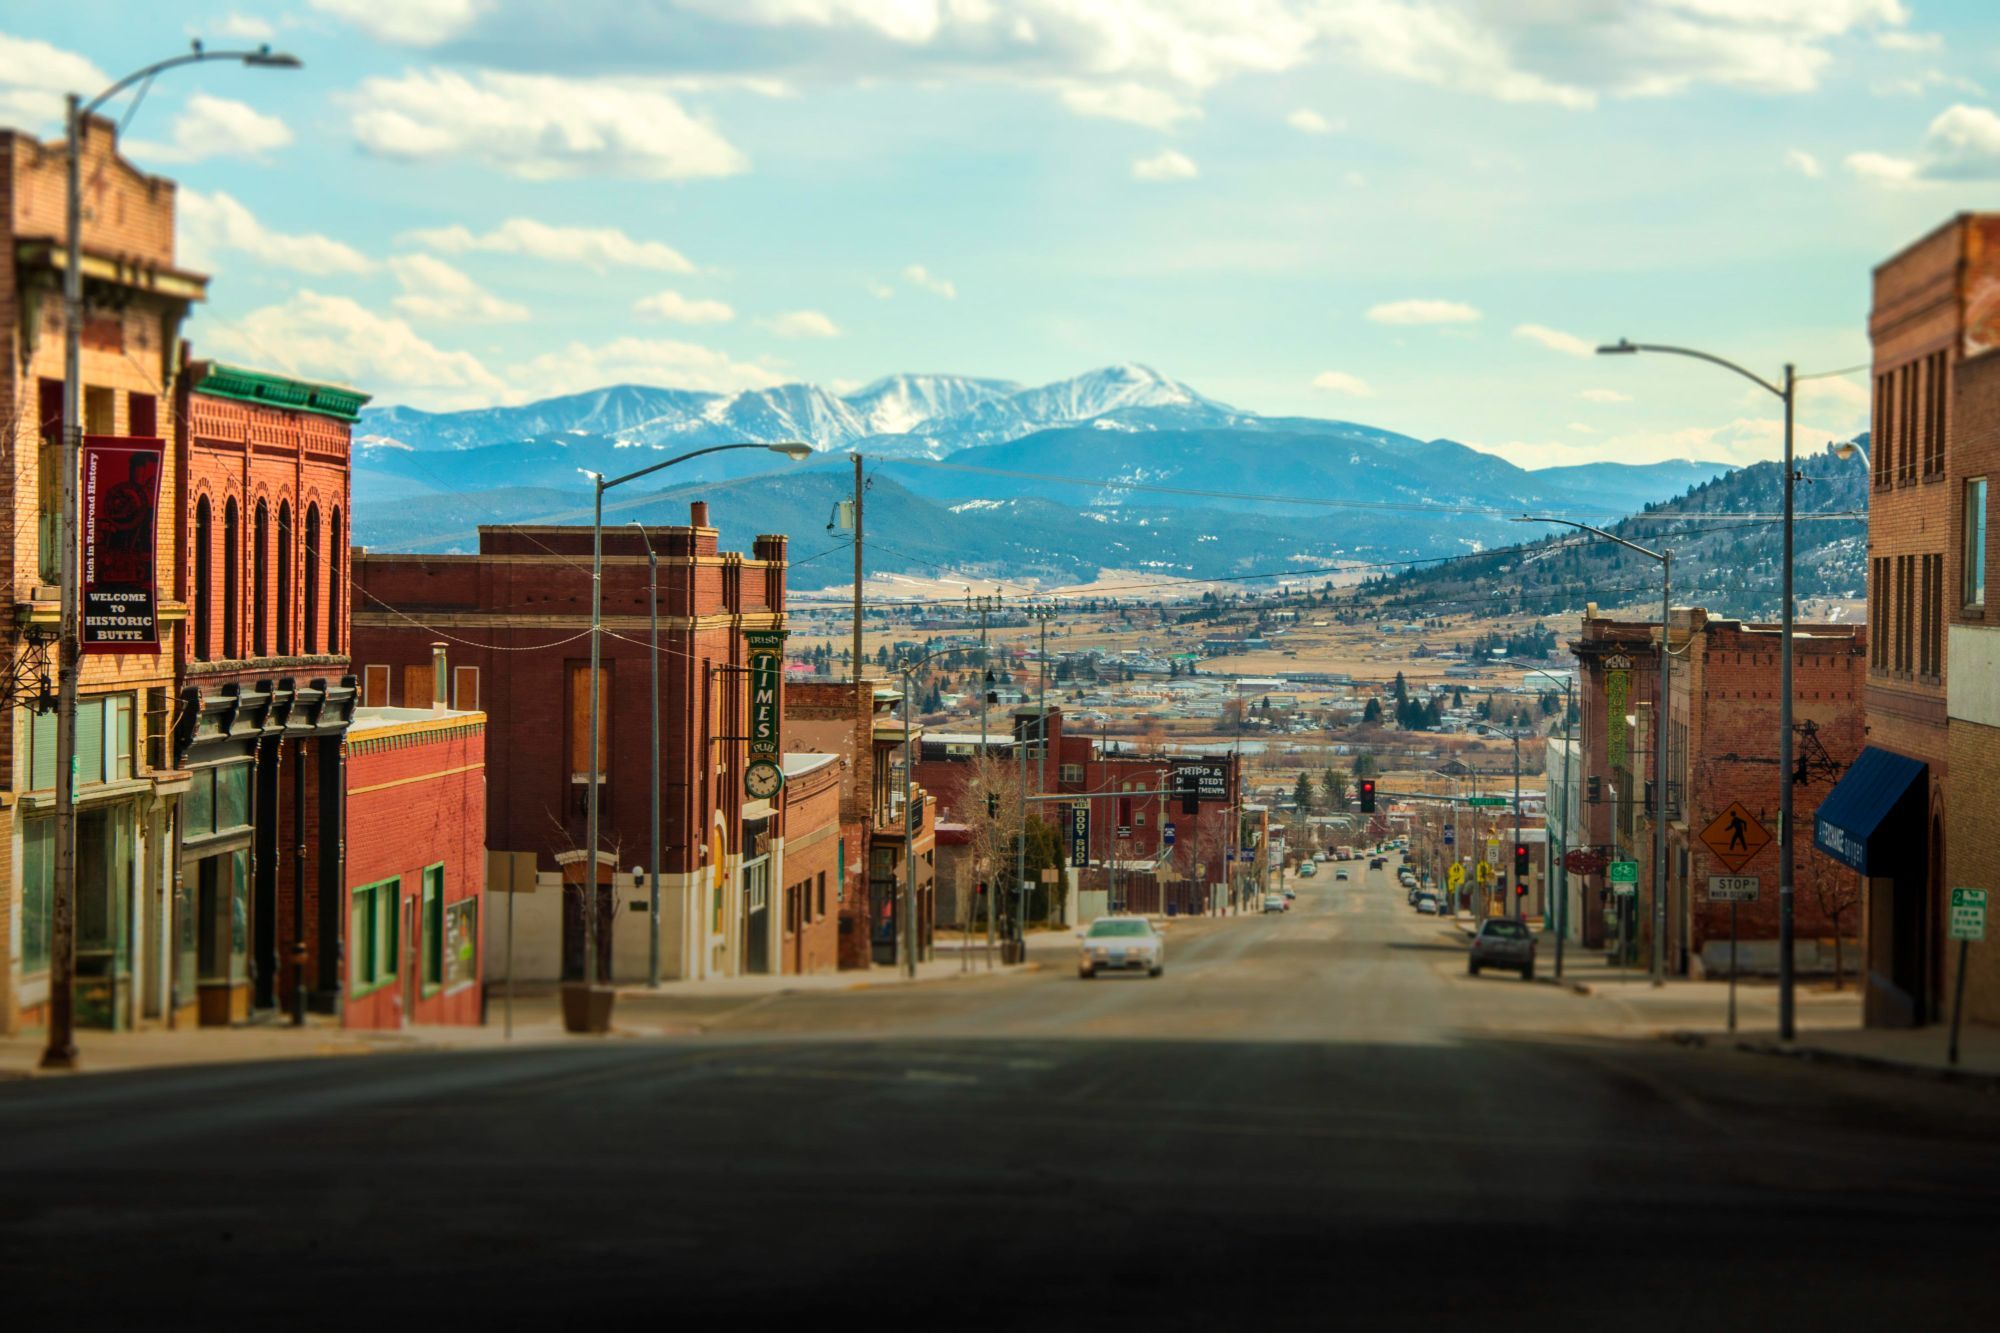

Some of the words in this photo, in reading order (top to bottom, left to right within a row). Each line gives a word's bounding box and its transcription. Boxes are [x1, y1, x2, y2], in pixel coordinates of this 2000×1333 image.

[87, 453, 99, 495] History
[86, 495, 96, 544] Railroad
[86, 545, 95, 556] in
[86, 557, 95, 583] Rich
[90, 593, 147, 602] WELCOME
[110, 605, 126, 613] TO
[86, 616, 153, 626] HISTORIC
[97, 630, 143, 640] BUTTE
[755, 655, 773, 738] TIMES
[753, 743, 774, 753] PUB
[1177, 767, 1211, 776] TRIPP
[1213, 768, 1223, 777] &
[1176, 777, 1225, 786] DSTEDT
[1076, 810, 1086, 836] BODY
[1075, 839, 1086, 865] SHOP
[1719, 879, 1750, 889] STOP
[1953, 891, 1961, 904] 2
